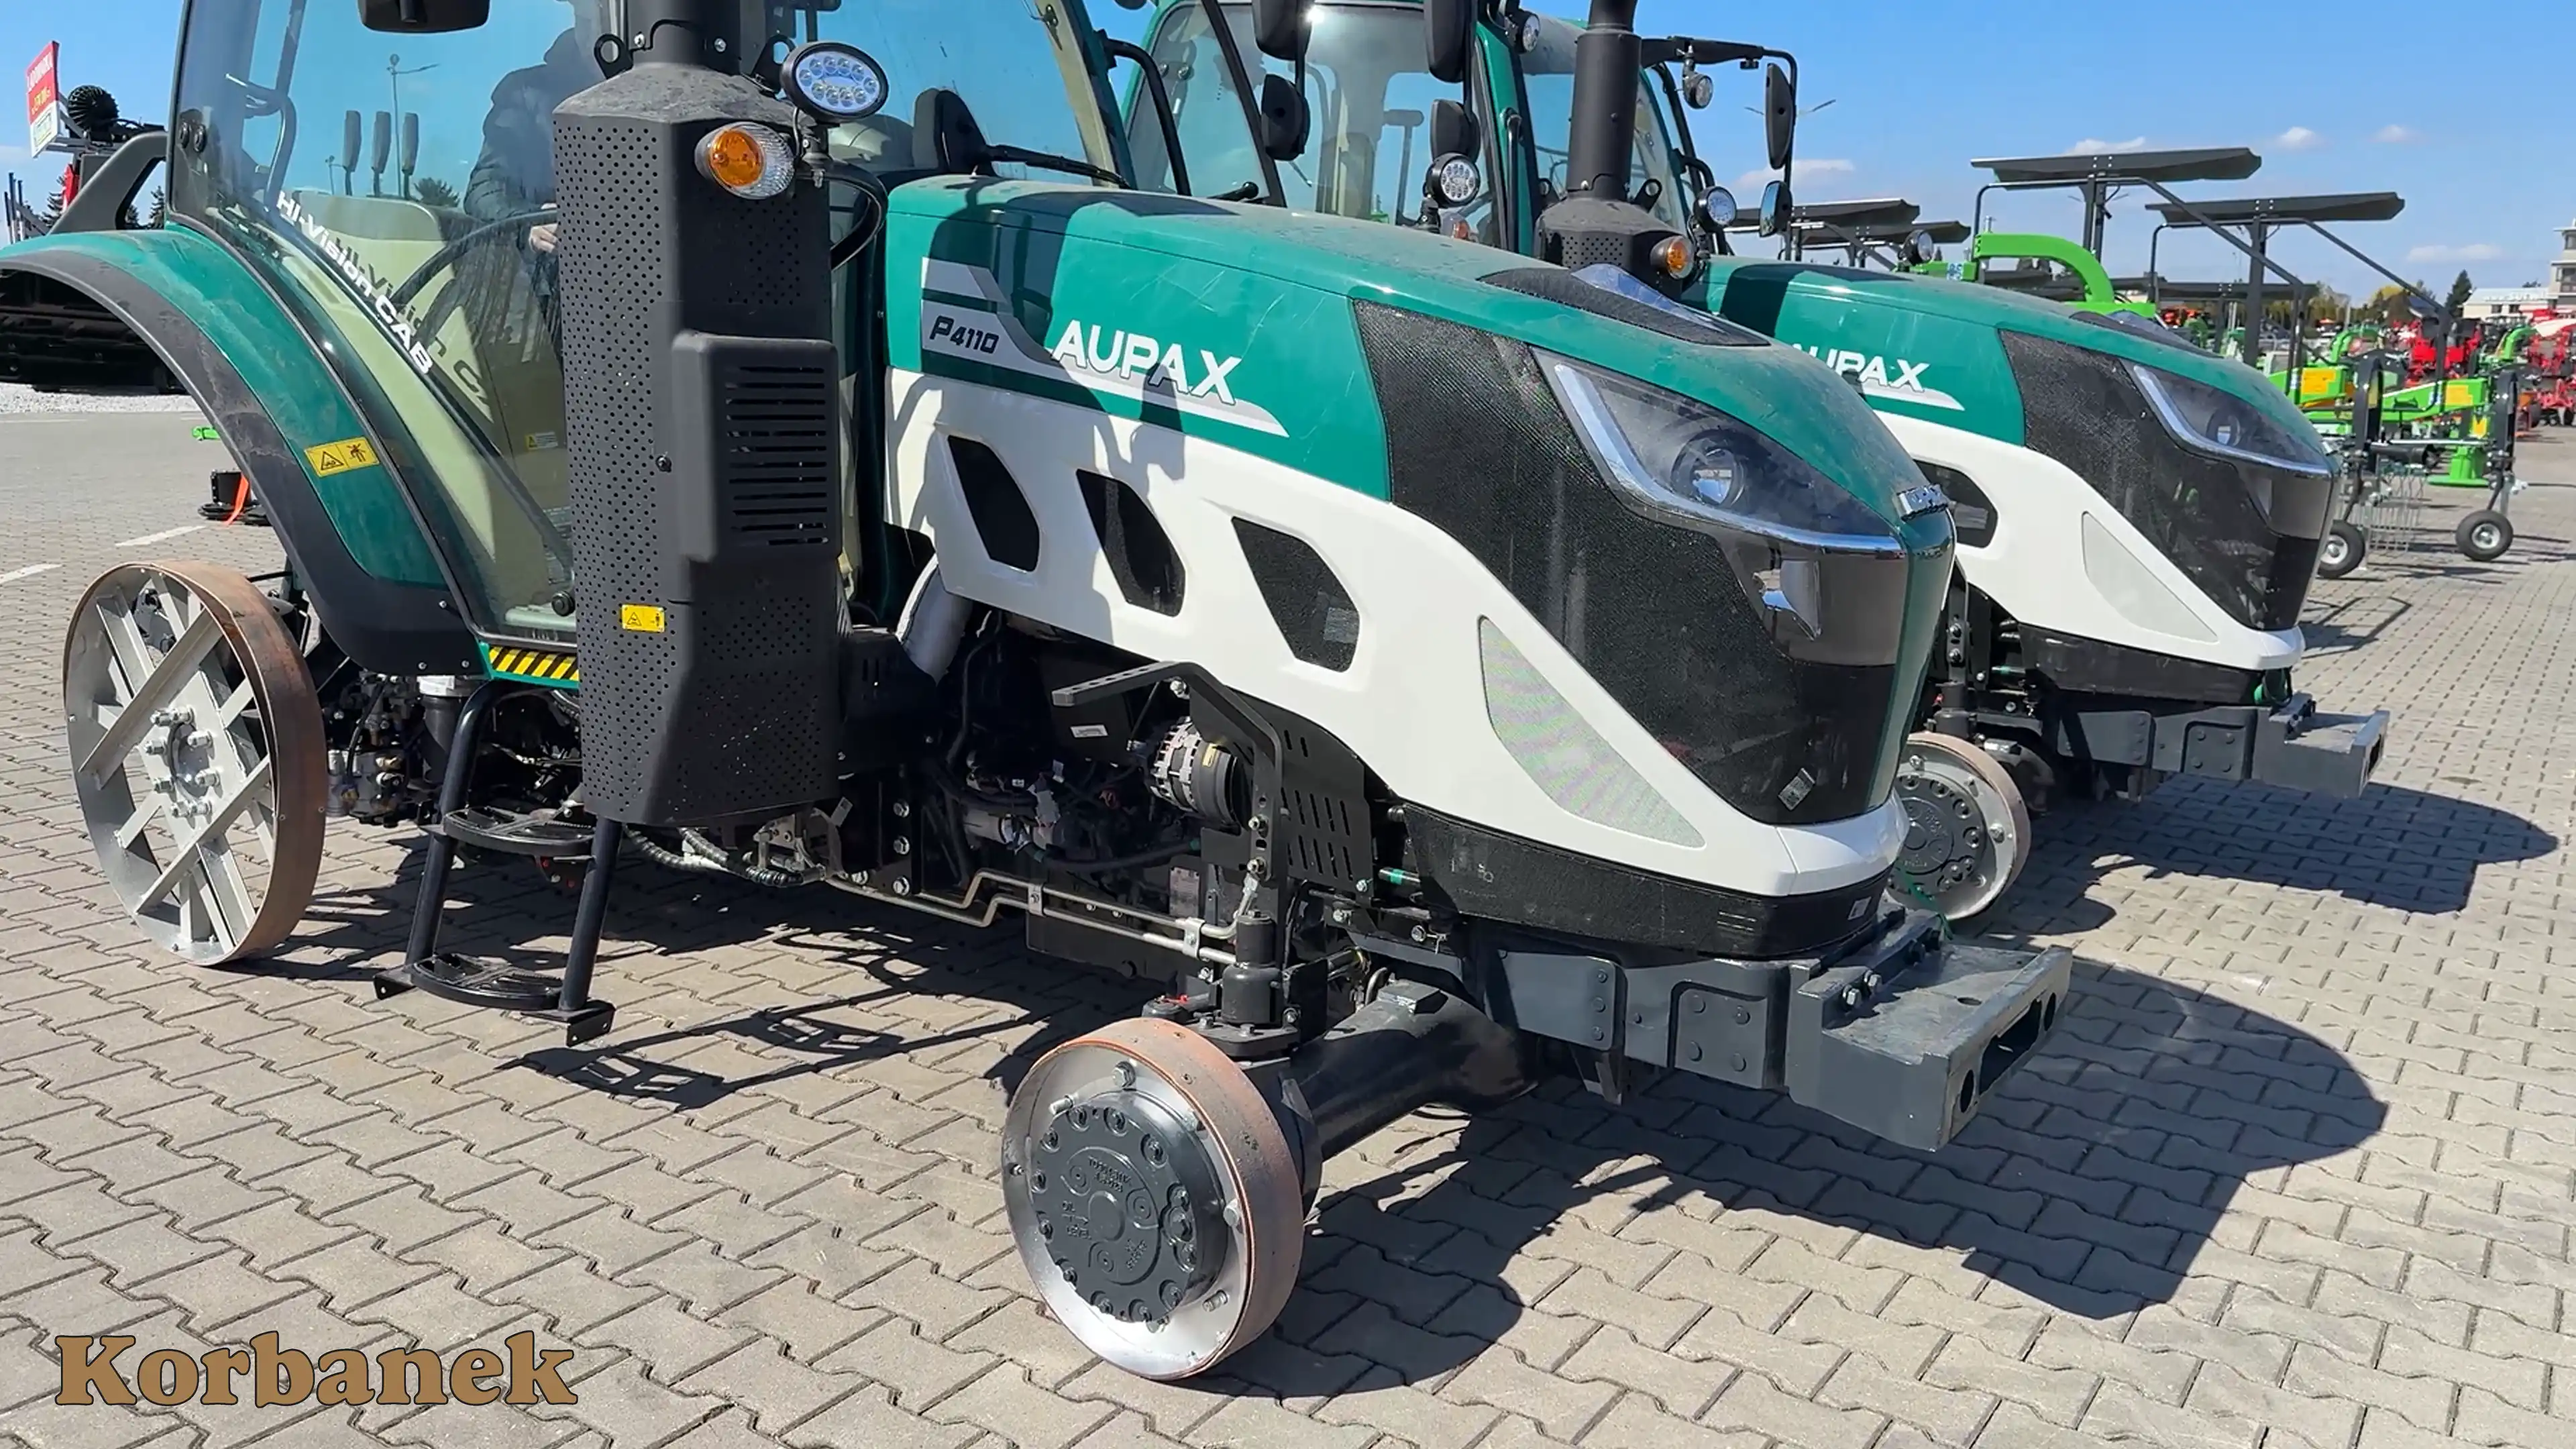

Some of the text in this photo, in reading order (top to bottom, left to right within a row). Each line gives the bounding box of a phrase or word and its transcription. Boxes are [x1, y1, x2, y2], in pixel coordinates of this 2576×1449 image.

[374, 294, 434, 374] CAB
[929, 315, 999, 354] P4110
[1051, 319, 1242, 405] AUPAX
[1792, 343, 1931, 394] PAX
